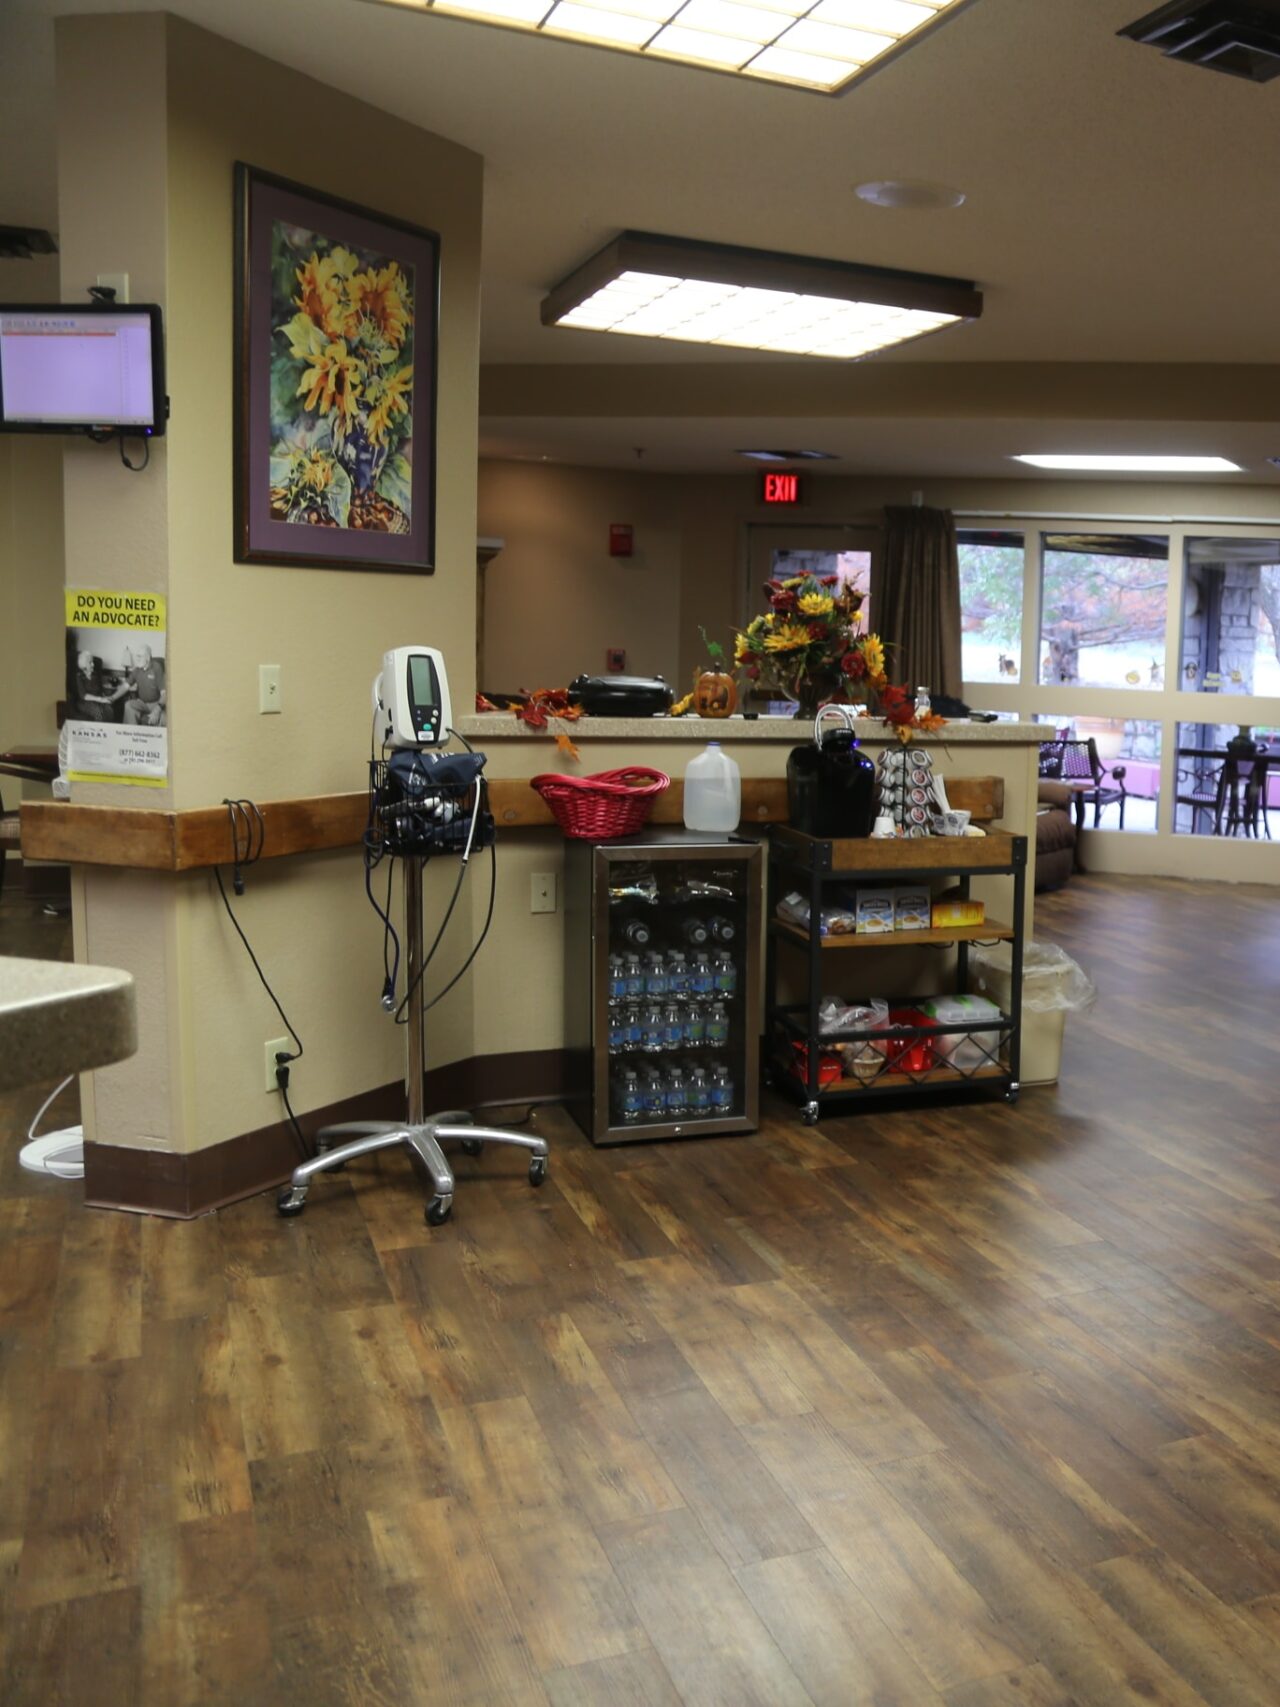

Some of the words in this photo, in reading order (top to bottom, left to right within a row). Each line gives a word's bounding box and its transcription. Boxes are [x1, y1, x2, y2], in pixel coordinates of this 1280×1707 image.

[765, 474, 797, 502] EXIT
[77, 595, 95, 608] DO
[98, 597, 122, 609] YOU
[125, 598, 156, 611] NEED
[73, 611, 90, 622] AN
[92, 612, 160, 627] ADVOCATE?
[72, 730, 107, 738] KANSAS
